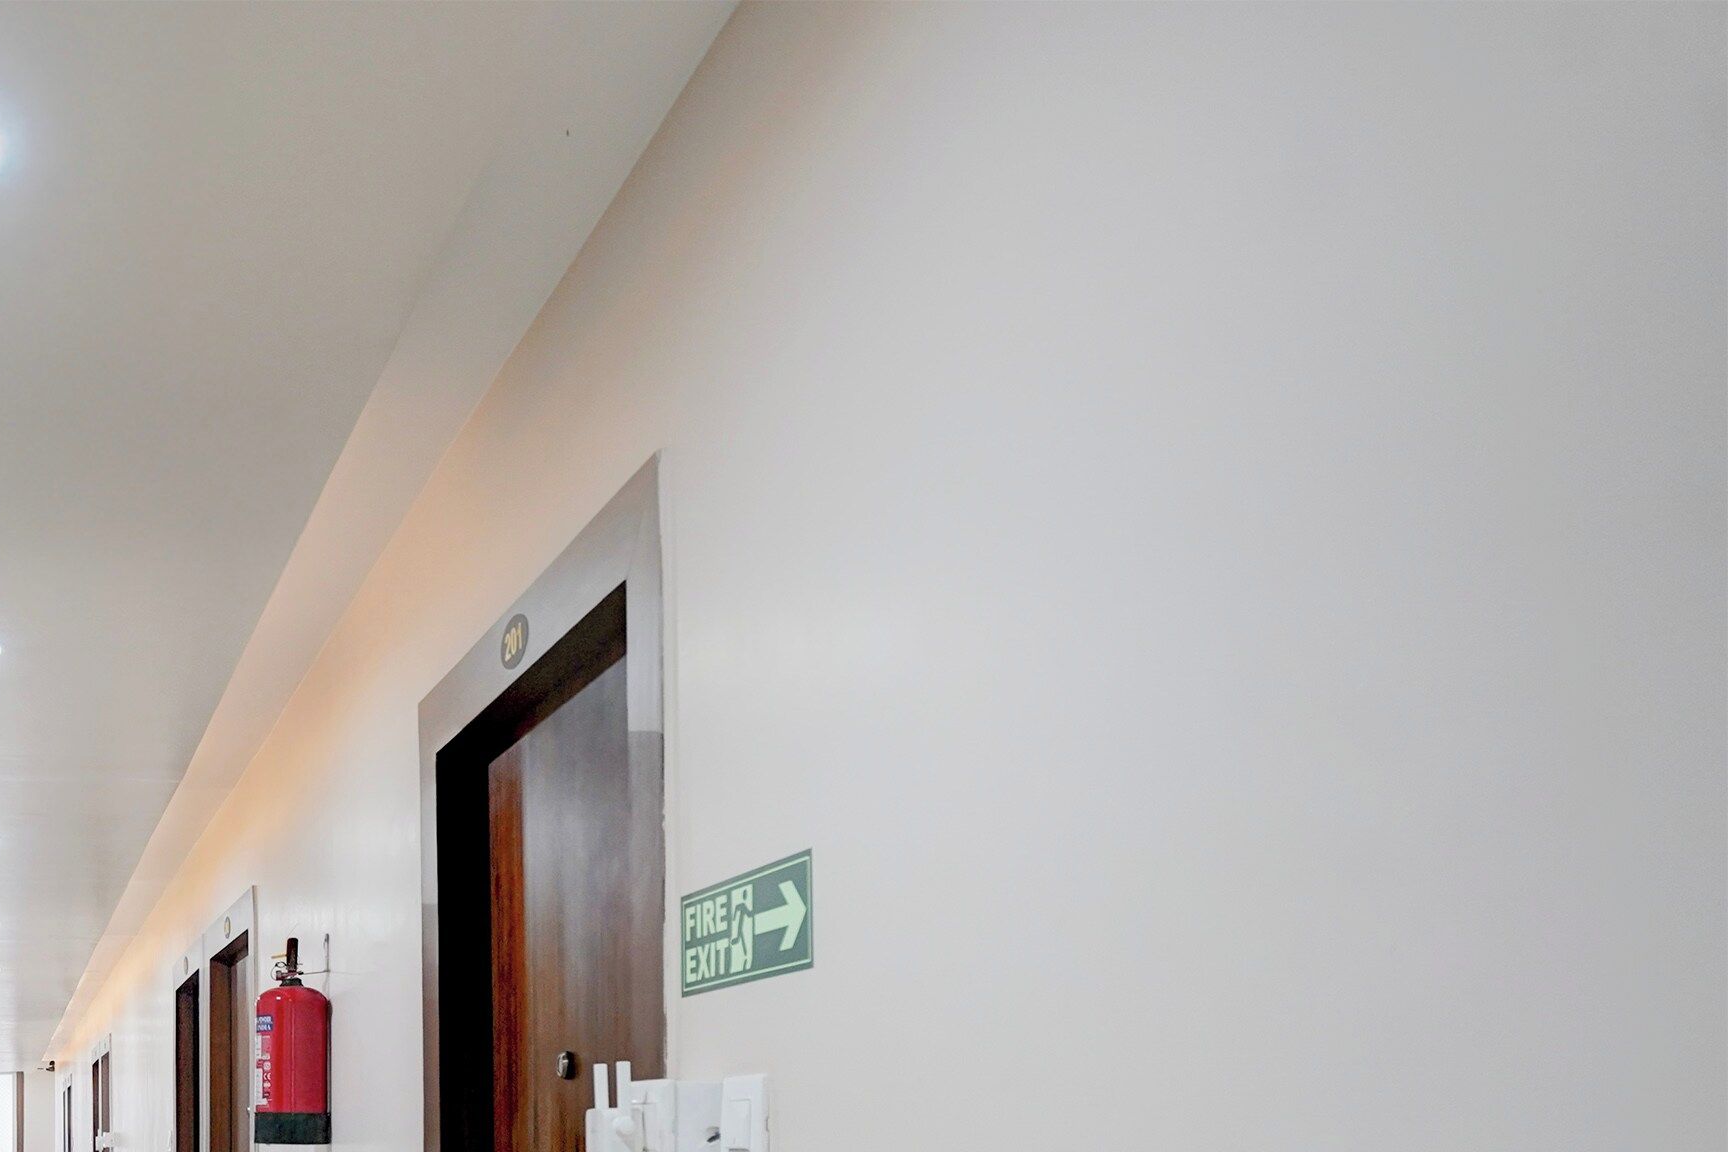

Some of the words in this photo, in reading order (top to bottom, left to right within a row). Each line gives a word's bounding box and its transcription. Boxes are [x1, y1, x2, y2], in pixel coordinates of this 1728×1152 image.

[504, 622, 522, 662] 201
[685, 894, 728, 942] FIRE
[685, 938, 730, 983] EXIT
